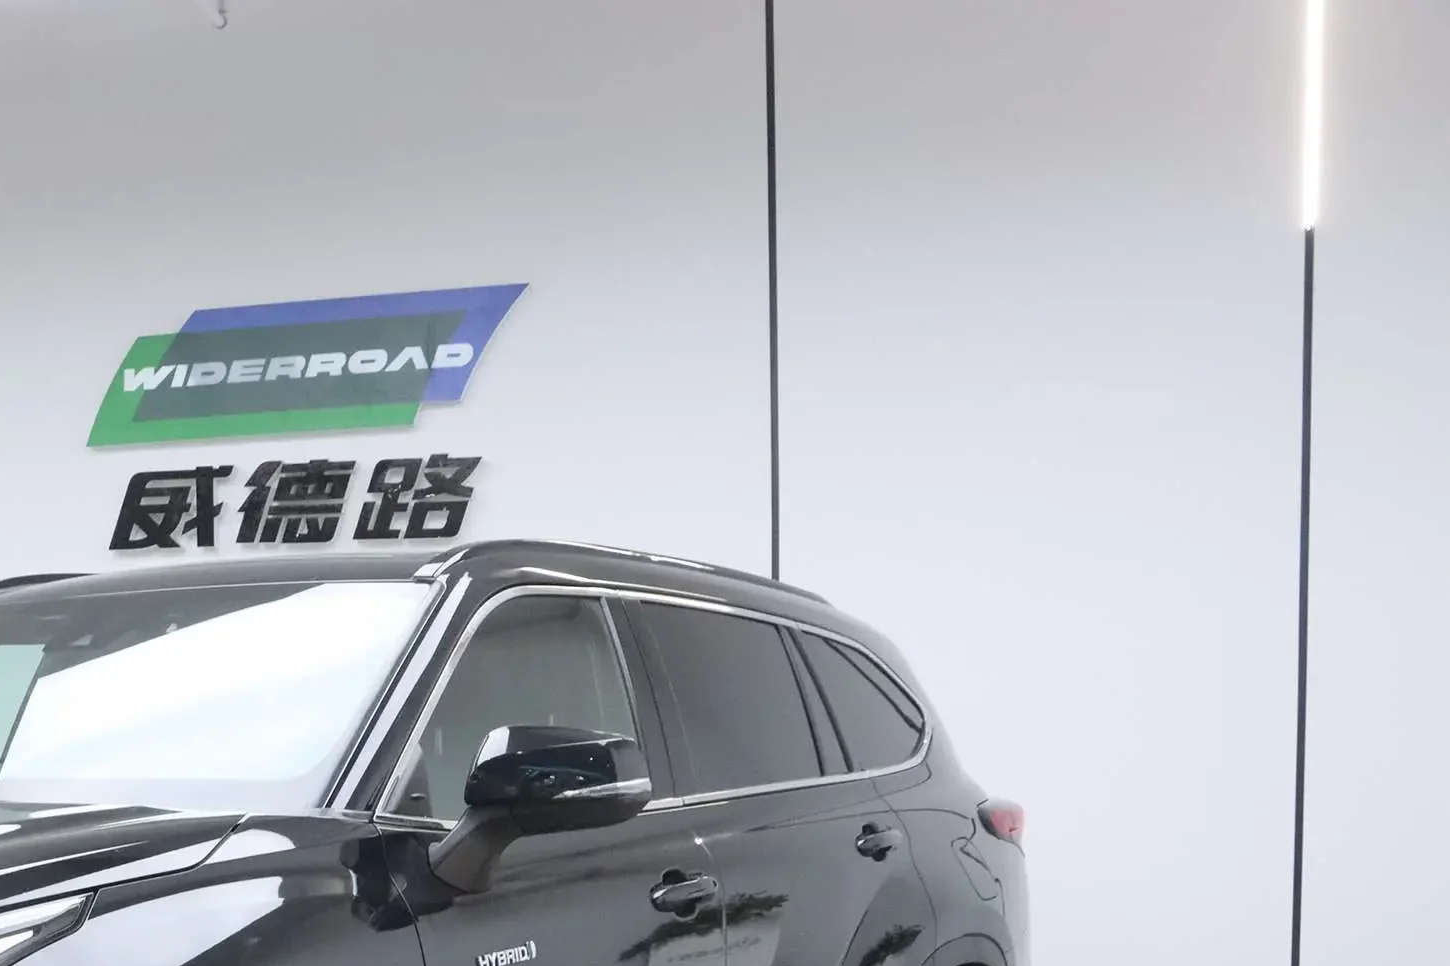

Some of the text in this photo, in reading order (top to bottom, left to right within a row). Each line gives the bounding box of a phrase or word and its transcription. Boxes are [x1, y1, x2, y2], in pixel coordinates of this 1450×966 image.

[123, 343, 474, 392] WIDERROAD
[108, 453, 483, 551] 威德路
